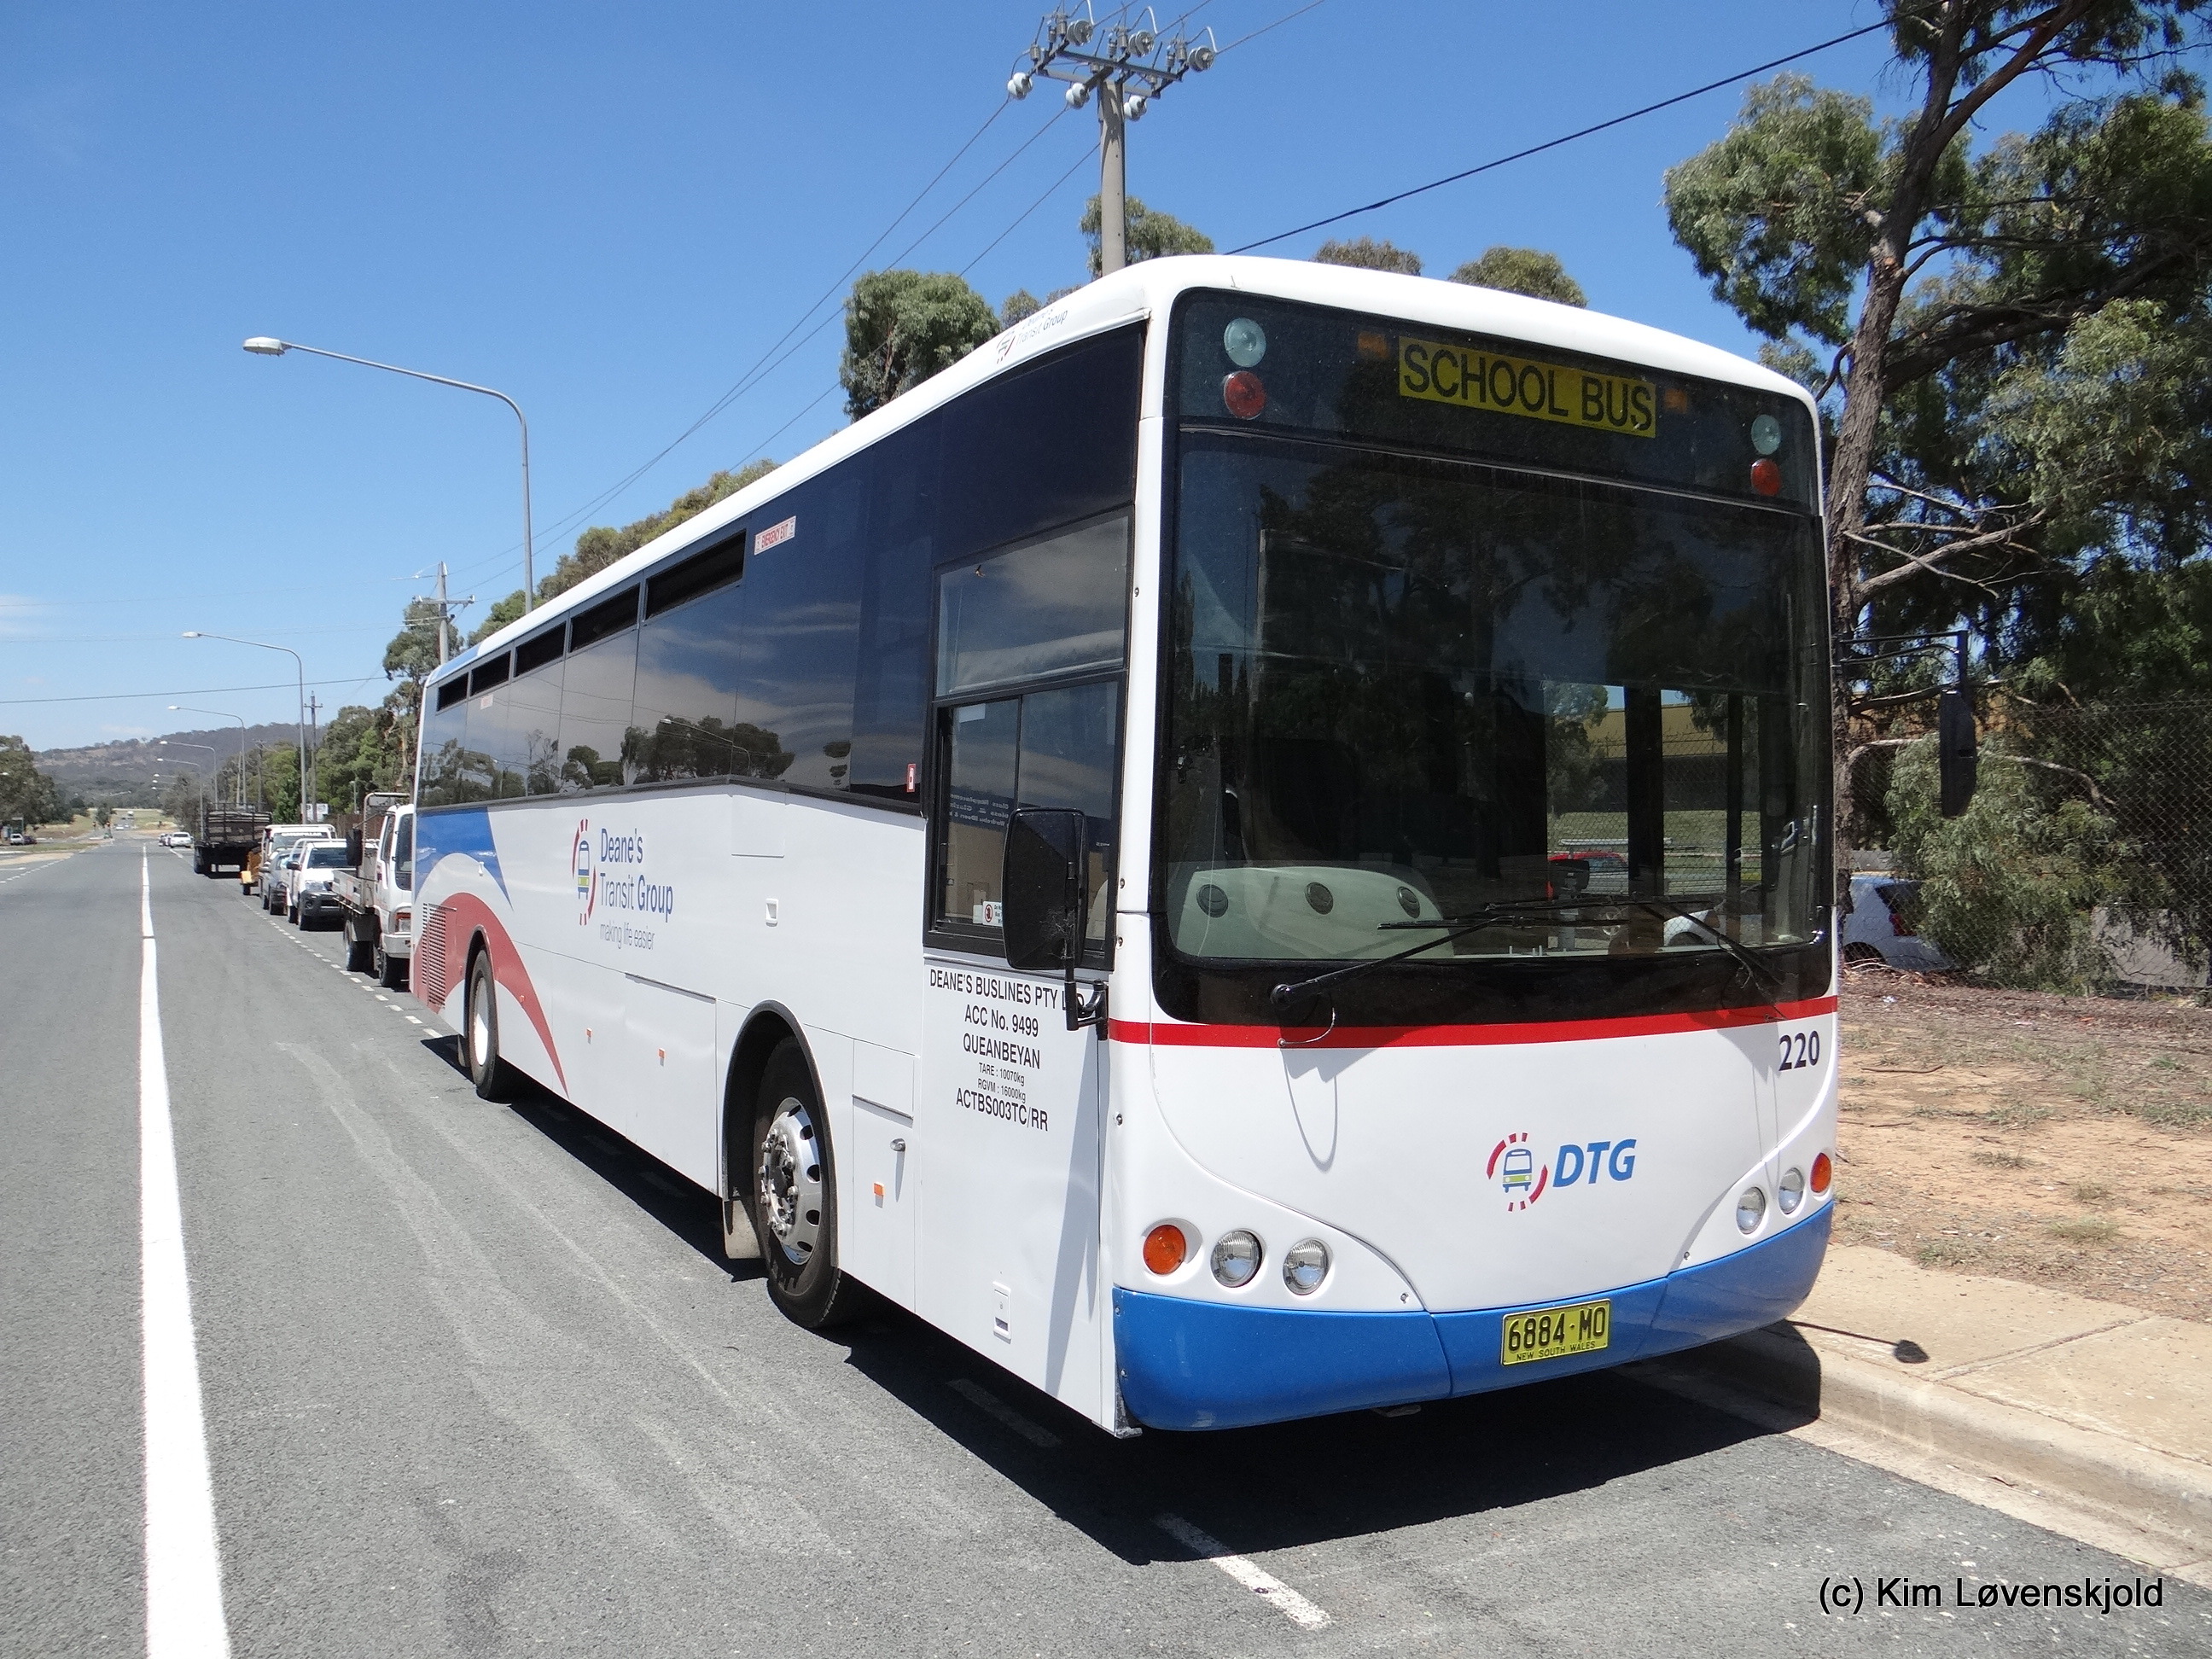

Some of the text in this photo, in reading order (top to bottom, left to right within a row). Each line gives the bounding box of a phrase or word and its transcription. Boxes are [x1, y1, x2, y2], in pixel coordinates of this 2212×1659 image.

[1043, 310, 1068, 331] Group
[1403, 343, 1653, 431] SCHOOL BUS
[601, 828, 643, 864] Deane's
[600, 873, 673, 923] Transit Group
[600, 919, 655, 950] making life easier
[930, 969, 973, 993] DEANE'S
[976, 977, 1031, 1004] BUSLINES
[1035, 987, 1058, 1009] PTY
[965, 1004, 1039, 1037] ACC No. 9499
[963, 1033, 1040, 1069] QUEANBEYAN
[1778, 1030, 1820, 1071] 220
[978, 1078, 996, 1093] RGVM
[1001, 1085, 1026, 1104] 16000kg
[979, 1062, 994, 1076] TARE
[1000, 1068, 1025, 1087] 10070kg
[956, 1087, 1048, 1132] ACTBS003TC/RR
[1552, 1138, 1637, 1188] DTG
[1516, 1341, 1595, 1361] NEW SOUTH WALES
